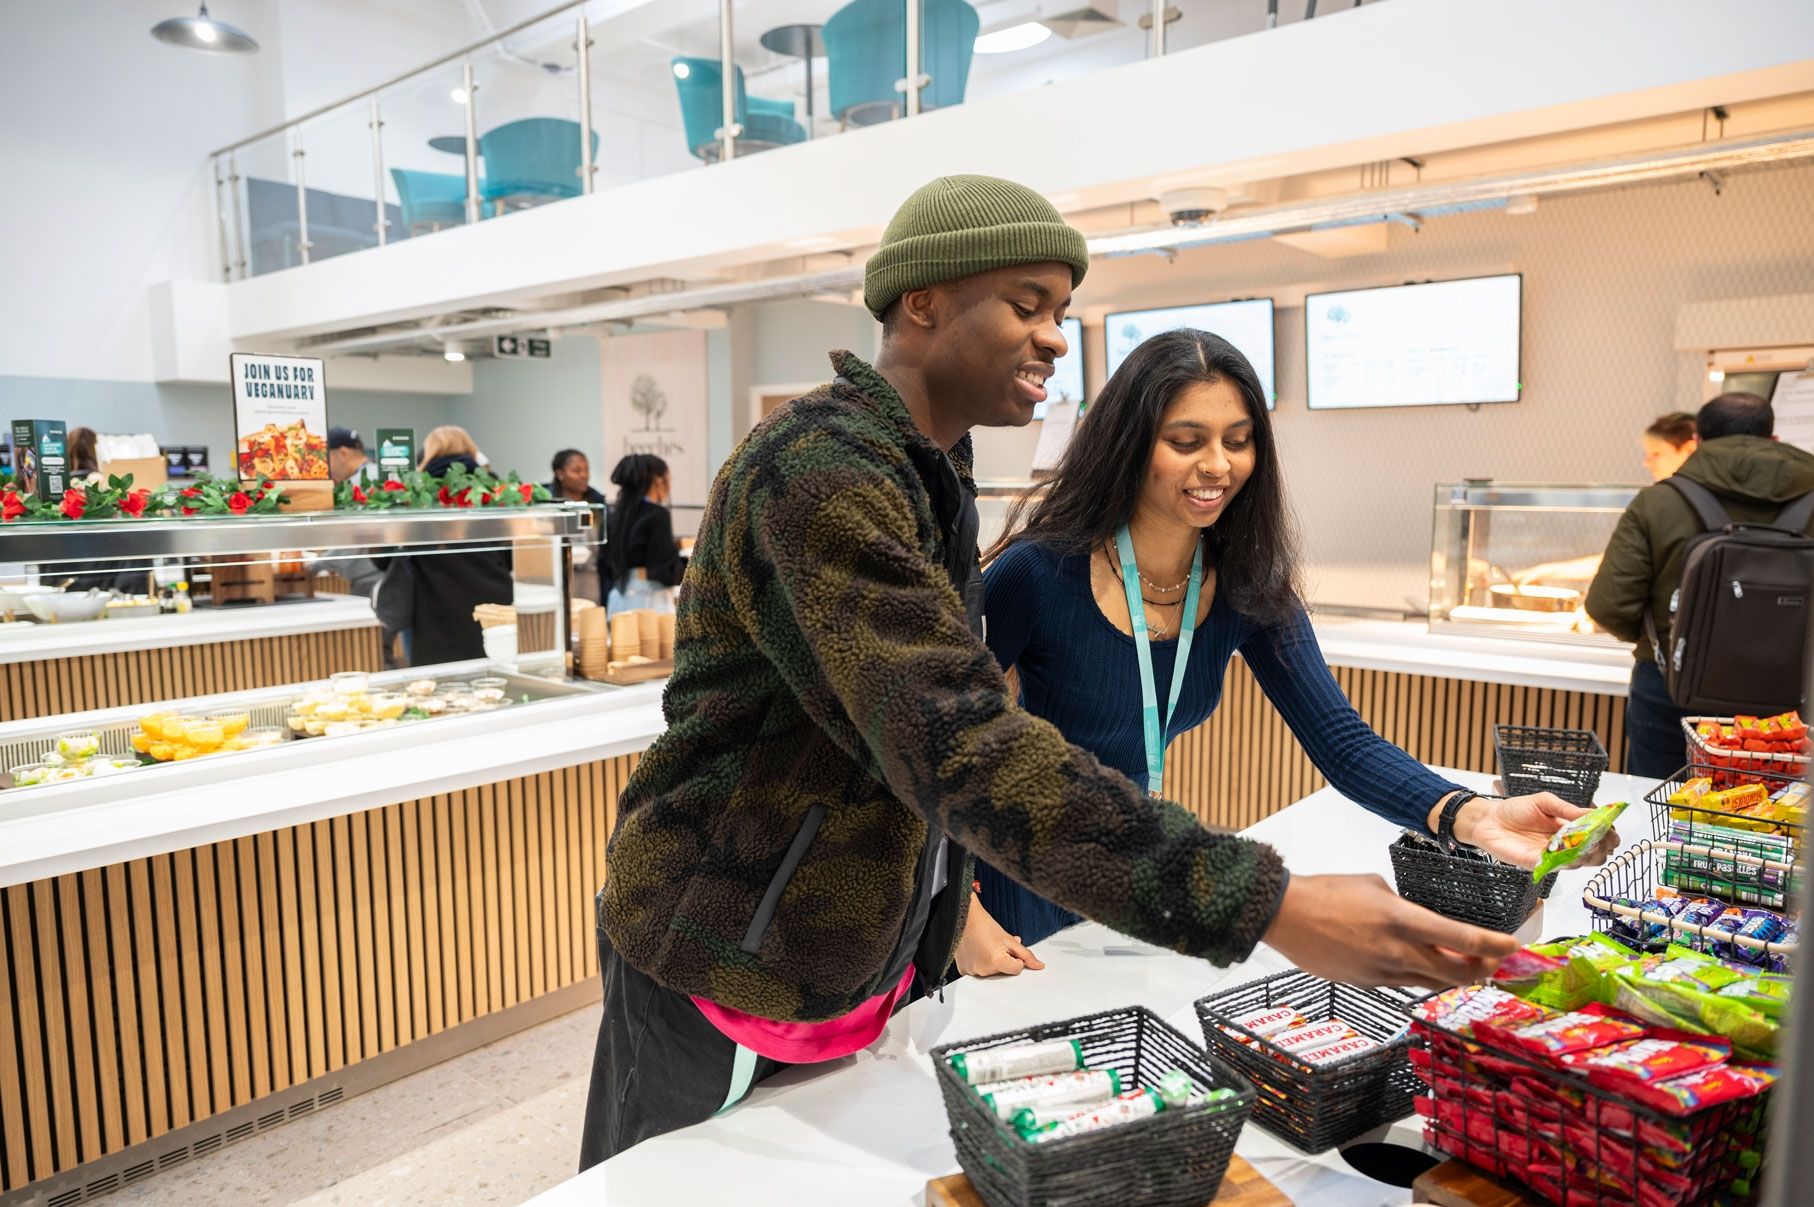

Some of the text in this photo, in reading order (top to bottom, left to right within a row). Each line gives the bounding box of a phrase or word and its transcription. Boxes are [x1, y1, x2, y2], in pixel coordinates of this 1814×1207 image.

[244, 363, 314, 382] JOIN US FOR
[245, 382, 314, 401] VEGANUARY
[1244, 1009, 1292, 1030] CARAM
[1276, 1024, 1343, 1048] CARAMEL
[1301, 1039, 1369, 1062] CARAMEL
